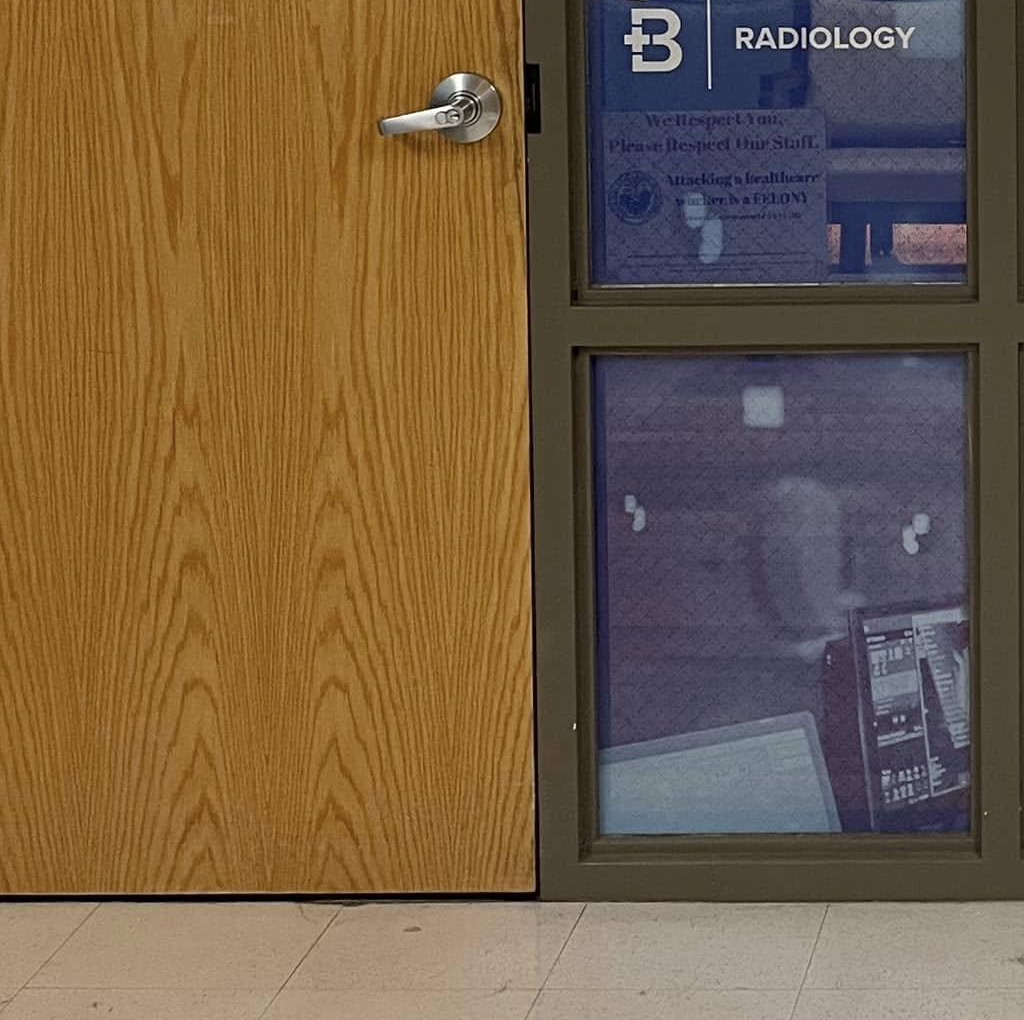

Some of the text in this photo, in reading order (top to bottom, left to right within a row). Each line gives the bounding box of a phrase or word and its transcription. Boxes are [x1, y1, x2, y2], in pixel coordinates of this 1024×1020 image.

[735, 27, 915, 50] RADIOLOGY
[645, 114, 671, 128] We
[672, 113, 742, 130] Respect
[665, 137, 730, 155] Respect
